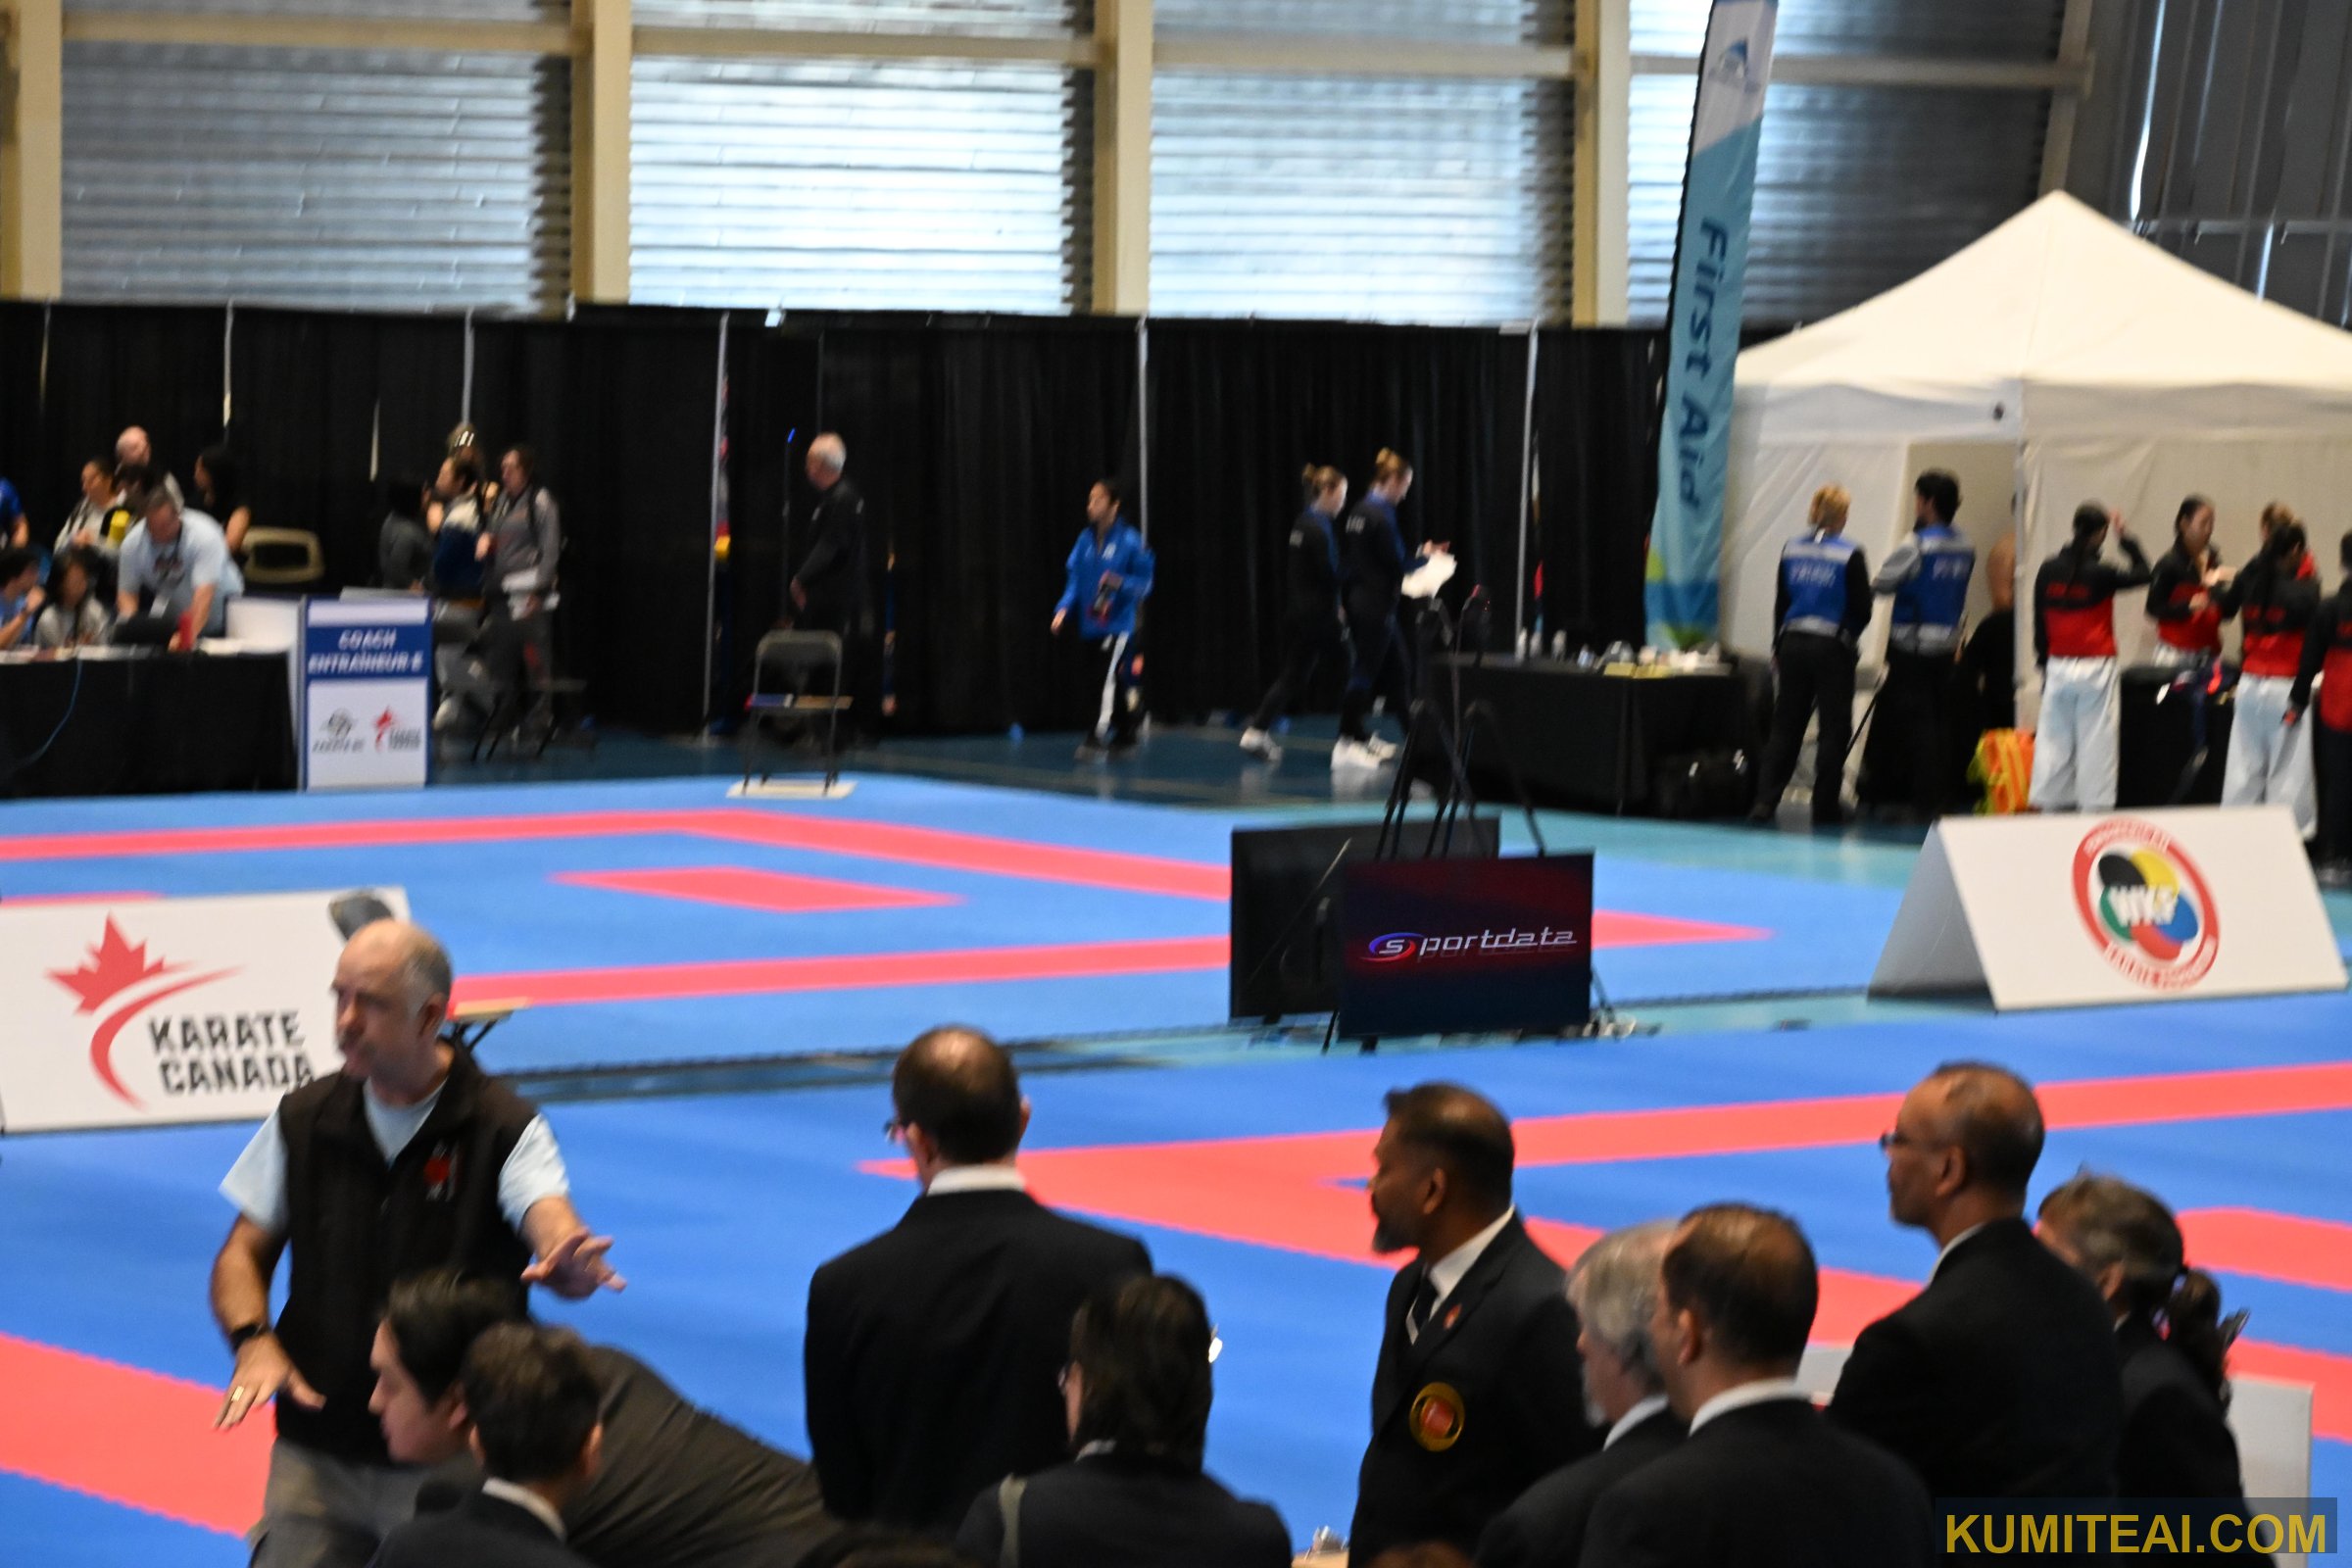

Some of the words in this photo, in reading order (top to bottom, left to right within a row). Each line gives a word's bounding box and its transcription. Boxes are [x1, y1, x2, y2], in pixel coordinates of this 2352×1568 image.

[1685, 218, 1728, 380] First
[1679, 390, 1710, 510] Aid
[338, 628, 397, 650] COACH
[149, 1010, 305, 1053] KARATE
[160, 1052, 315, 1095] CANADA
